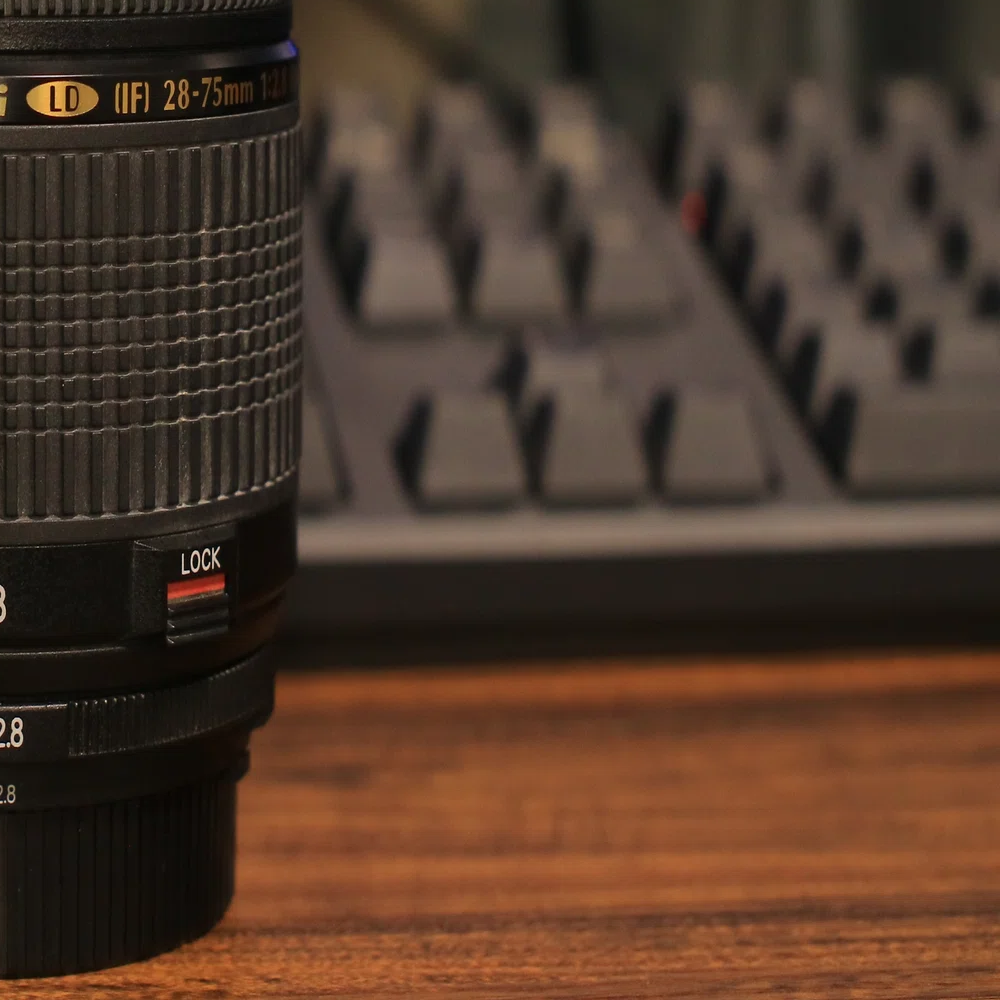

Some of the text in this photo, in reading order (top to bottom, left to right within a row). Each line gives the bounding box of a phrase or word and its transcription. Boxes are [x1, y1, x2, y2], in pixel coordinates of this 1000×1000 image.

[114, 81, 150, 114] (IF)
[163, 75, 253, 111] 28-75mm
[181, 546, 221, 575] LOCK
